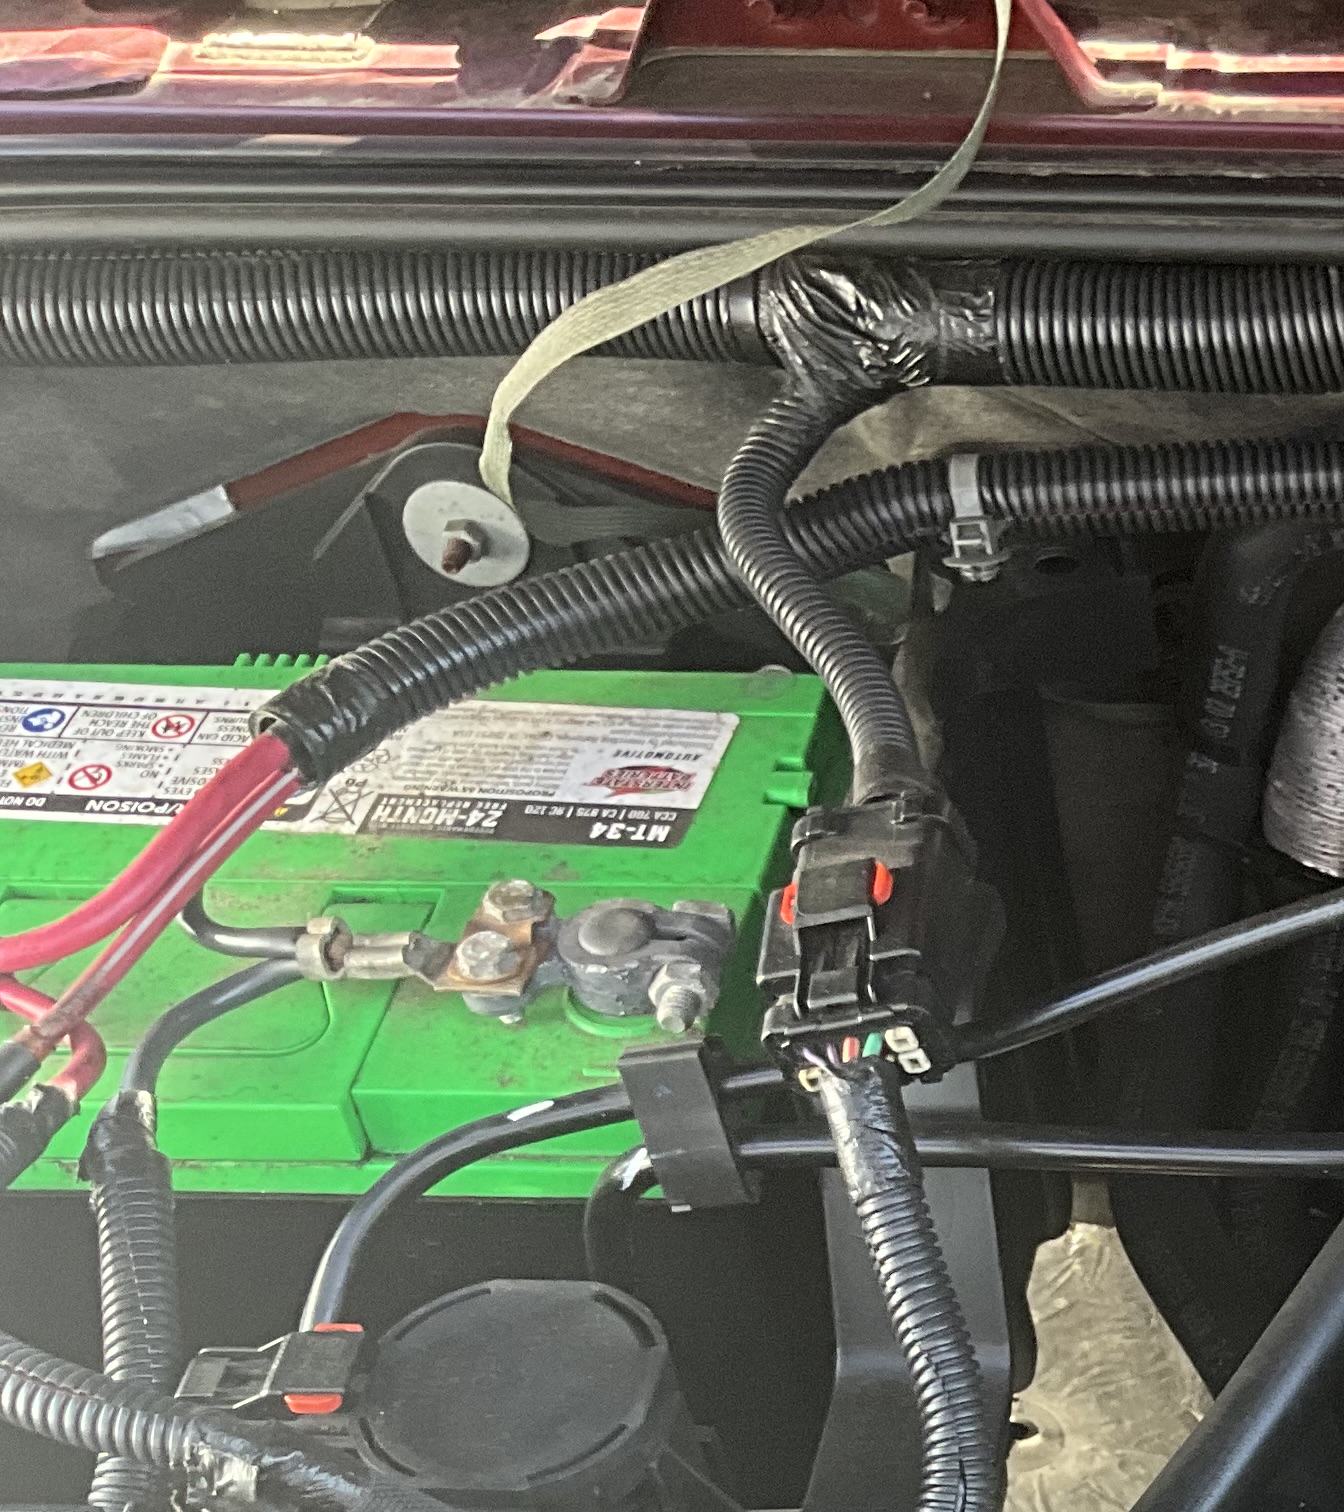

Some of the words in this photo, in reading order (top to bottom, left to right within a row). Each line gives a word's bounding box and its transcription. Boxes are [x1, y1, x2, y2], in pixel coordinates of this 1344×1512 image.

[81, 710, 140, 720] CHILDREN
[141, 712, 158, 721] OF
[88, 719, 129, 728] REACH
[129, 720, 151, 729] THE
[73, 728, 89, 736] OF
[91, 728, 114, 737] OUT
[116, 729, 146, 738] KEEP
[197, 733, 219, 741] CAN
[221, 734, 250, 743] ACID
[22, 740, 75, 749] MEDICAL
[115, 744, 165, 753] SMOKING
[37, 750, 69, 760] WITH
[119, 753, 161, 761] FLAMES
[611, 749, 703, 762] AUTOMOTIVE
[115, 761, 155, 769] SPARKS
[139, 770, 160, 778] NO
[606, 768, 693, 781] BATTERIES
[171, 777, 207, 786] OSIVE
[592, 777, 692, 791] INTERSTATE
[164, 787, 193, 796] EYES
[402, 784, 459, 793] WARNING
[477, 788, 556, 797] PROPOSITION
[26, 797, 46, 807] DO
[378, 797, 472, 809] REPLACEMENT
[477, 801, 508, 811] FREE
[524, 804, 549, 815] 120
[601, 809, 618, 819] CA
[370, 804, 504, 828] 24-MONTH
[628, 810, 650, 820] 700
[654, 811, 677, 821] CCA
[589, 822, 671, 842] MT-34
